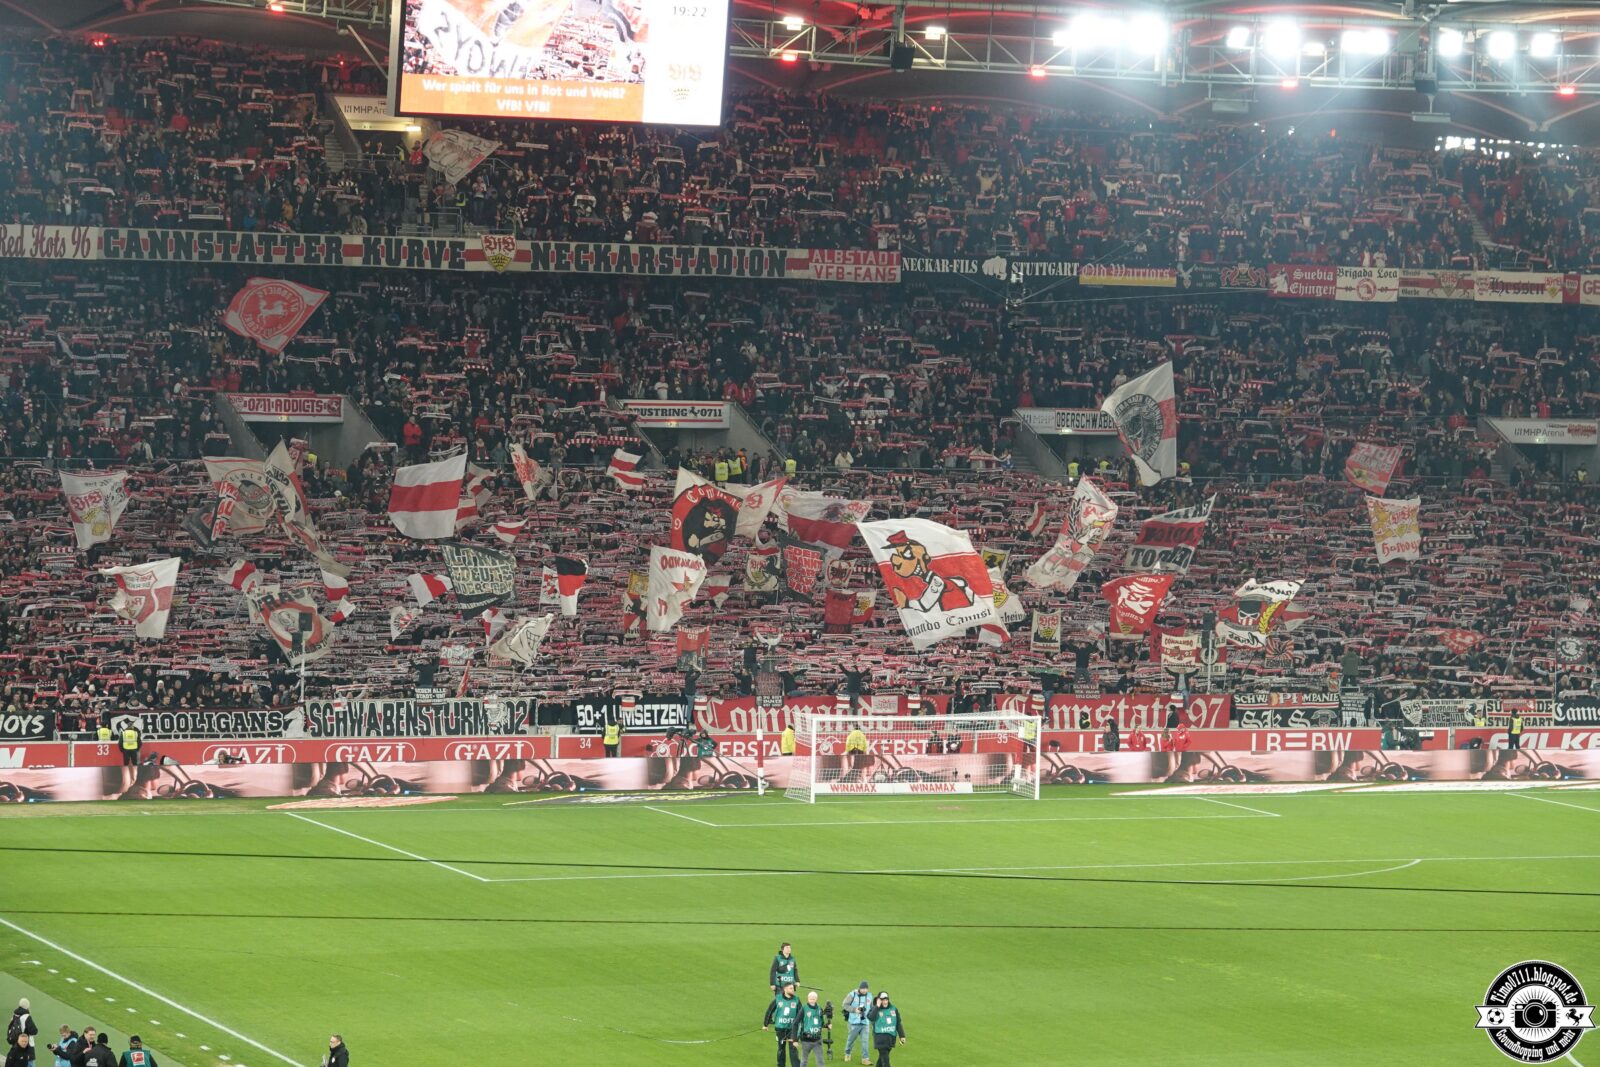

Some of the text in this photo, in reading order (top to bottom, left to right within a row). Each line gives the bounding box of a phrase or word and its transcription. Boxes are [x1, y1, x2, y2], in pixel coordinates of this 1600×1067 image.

[672, 6, 707, 18] 19:22
[421, 79, 625, 102] Wer spielt für uns in Rot und Weiß?
[354, 105, 373, 113] MHP
[30, 226, 66, 258] Hots
[71, 227, 91, 258] 96
[103, 229, 467, 270] CANNSTATTER KURVE
[530, 242, 788, 278] NECKARSTADION
[811, 249, 899, 267] ALBSTADT
[814, 266, 898, 281] VFB-FANS
[901, 257, 1080, 279] NECKAR-FILS STUTTGART
[1292, 268, 1335, 281] Suebia
[247, 398, 271, 413] 0711
[699, 409, 723, 417] 0711
[1524, 428, 1541, 436] MHP
[576, 703, 608, 726] 50+1
[1186, 698, 1223, 730] 97
[0, 714, 45, 733] OYS
[139, 711, 284, 734] HOOLIGANS
[578, 737, 591, 749] 34
[996, 734, 1008, 746] 35
[96, 745, 110, 756] 33
[830, 783, 877, 793] WINAMAX
[909, 783, 957, 793] WINAMAX
